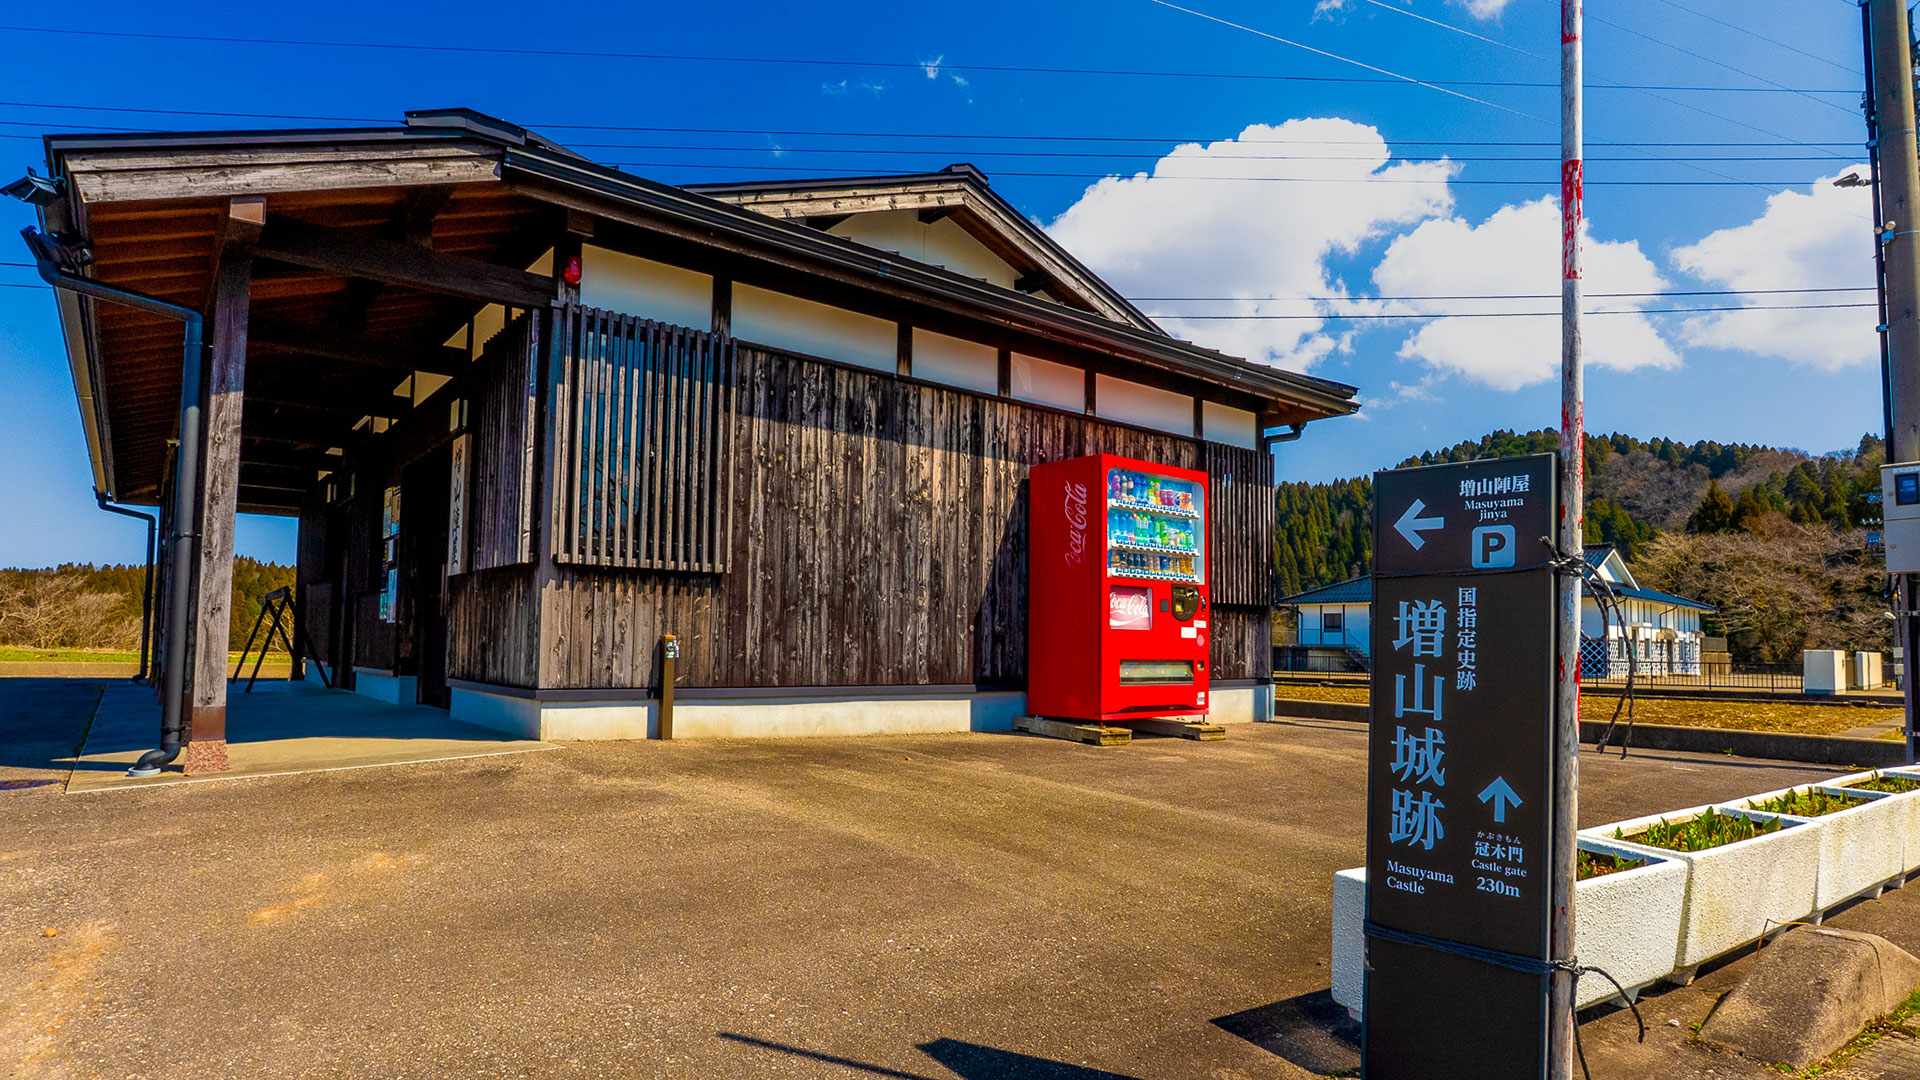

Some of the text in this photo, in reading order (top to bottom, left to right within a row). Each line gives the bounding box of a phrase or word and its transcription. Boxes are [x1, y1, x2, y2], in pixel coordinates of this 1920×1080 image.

[1459, 474, 1530, 497] 増山陣屋
[1464, 496, 1524, 510] Masuyama
[1478, 509, 1508, 522] jinya
[1481, 532, 1506, 564] P
[1456, 586, 1478, 691] 国指定史跡
[1388, 599, 1448, 850] 増山城跡
[1476, 831, 1521, 844] かぶきもん
[1474, 841, 1524, 864] 冠木門
[1387, 860, 1454, 884] Masuyama
[1471, 858, 1527, 877] Castle gate
[1387, 876, 1426, 895] Castle
[1476, 875, 1521, 898] 230m
